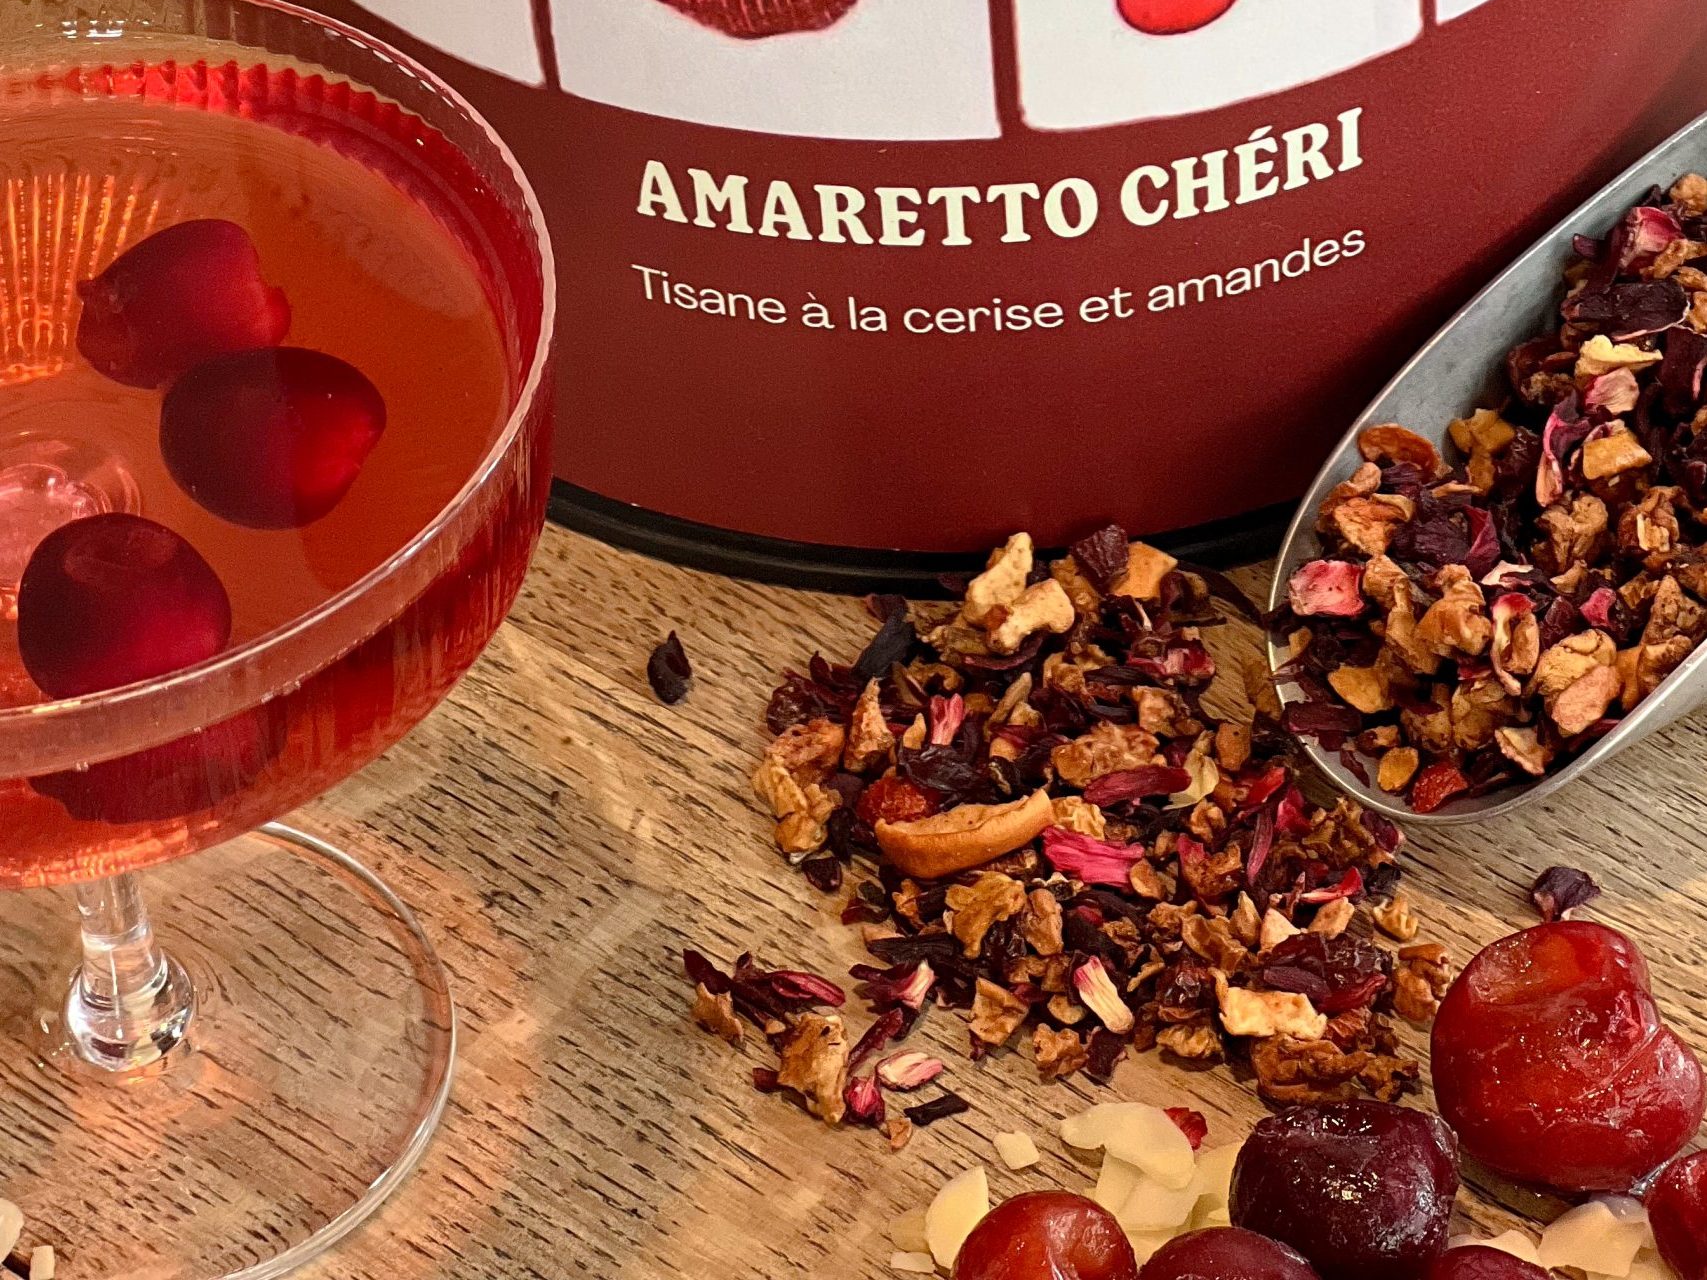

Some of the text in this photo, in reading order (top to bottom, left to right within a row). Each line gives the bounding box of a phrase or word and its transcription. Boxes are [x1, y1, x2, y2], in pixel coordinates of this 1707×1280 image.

[636, 106, 1363, 247] AMARETTO CHÉRI
[631, 229, 1366, 334] Tisane à la cerise et amandes
